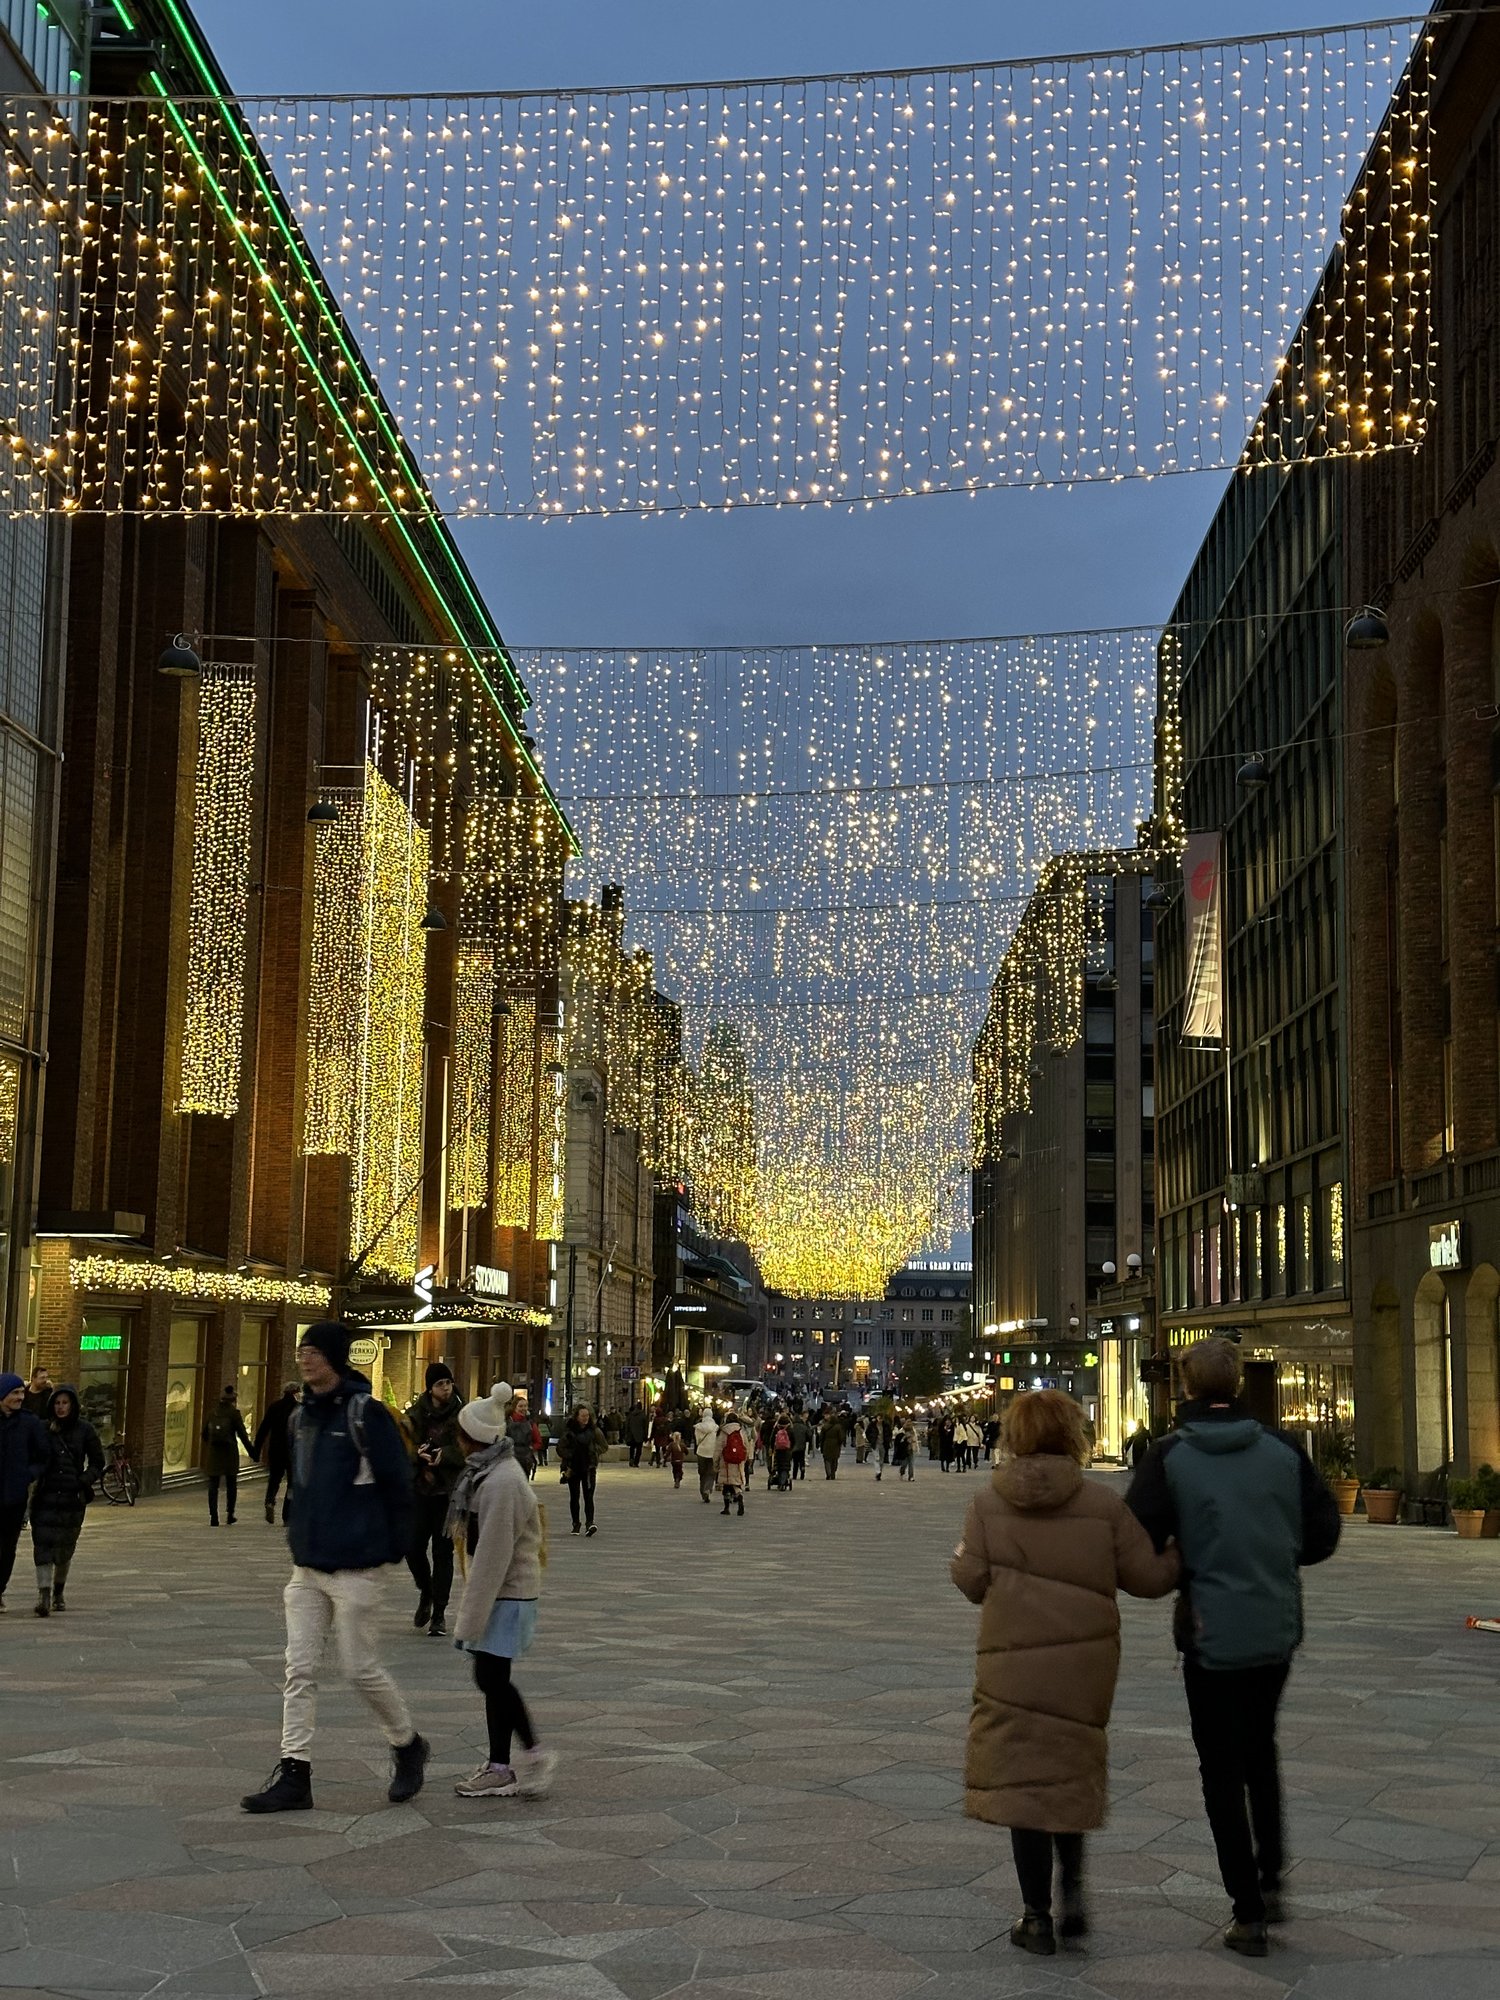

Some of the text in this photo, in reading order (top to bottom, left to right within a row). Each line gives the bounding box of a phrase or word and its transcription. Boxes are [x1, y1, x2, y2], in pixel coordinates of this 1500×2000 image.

[1191, 909, 1219, 1007] VISMA
[475, 1264, 509, 1296] STOCKMANN
[908, 1261, 927, 1271] HOTEL
[929, 1261, 951, 1271] GRAND
